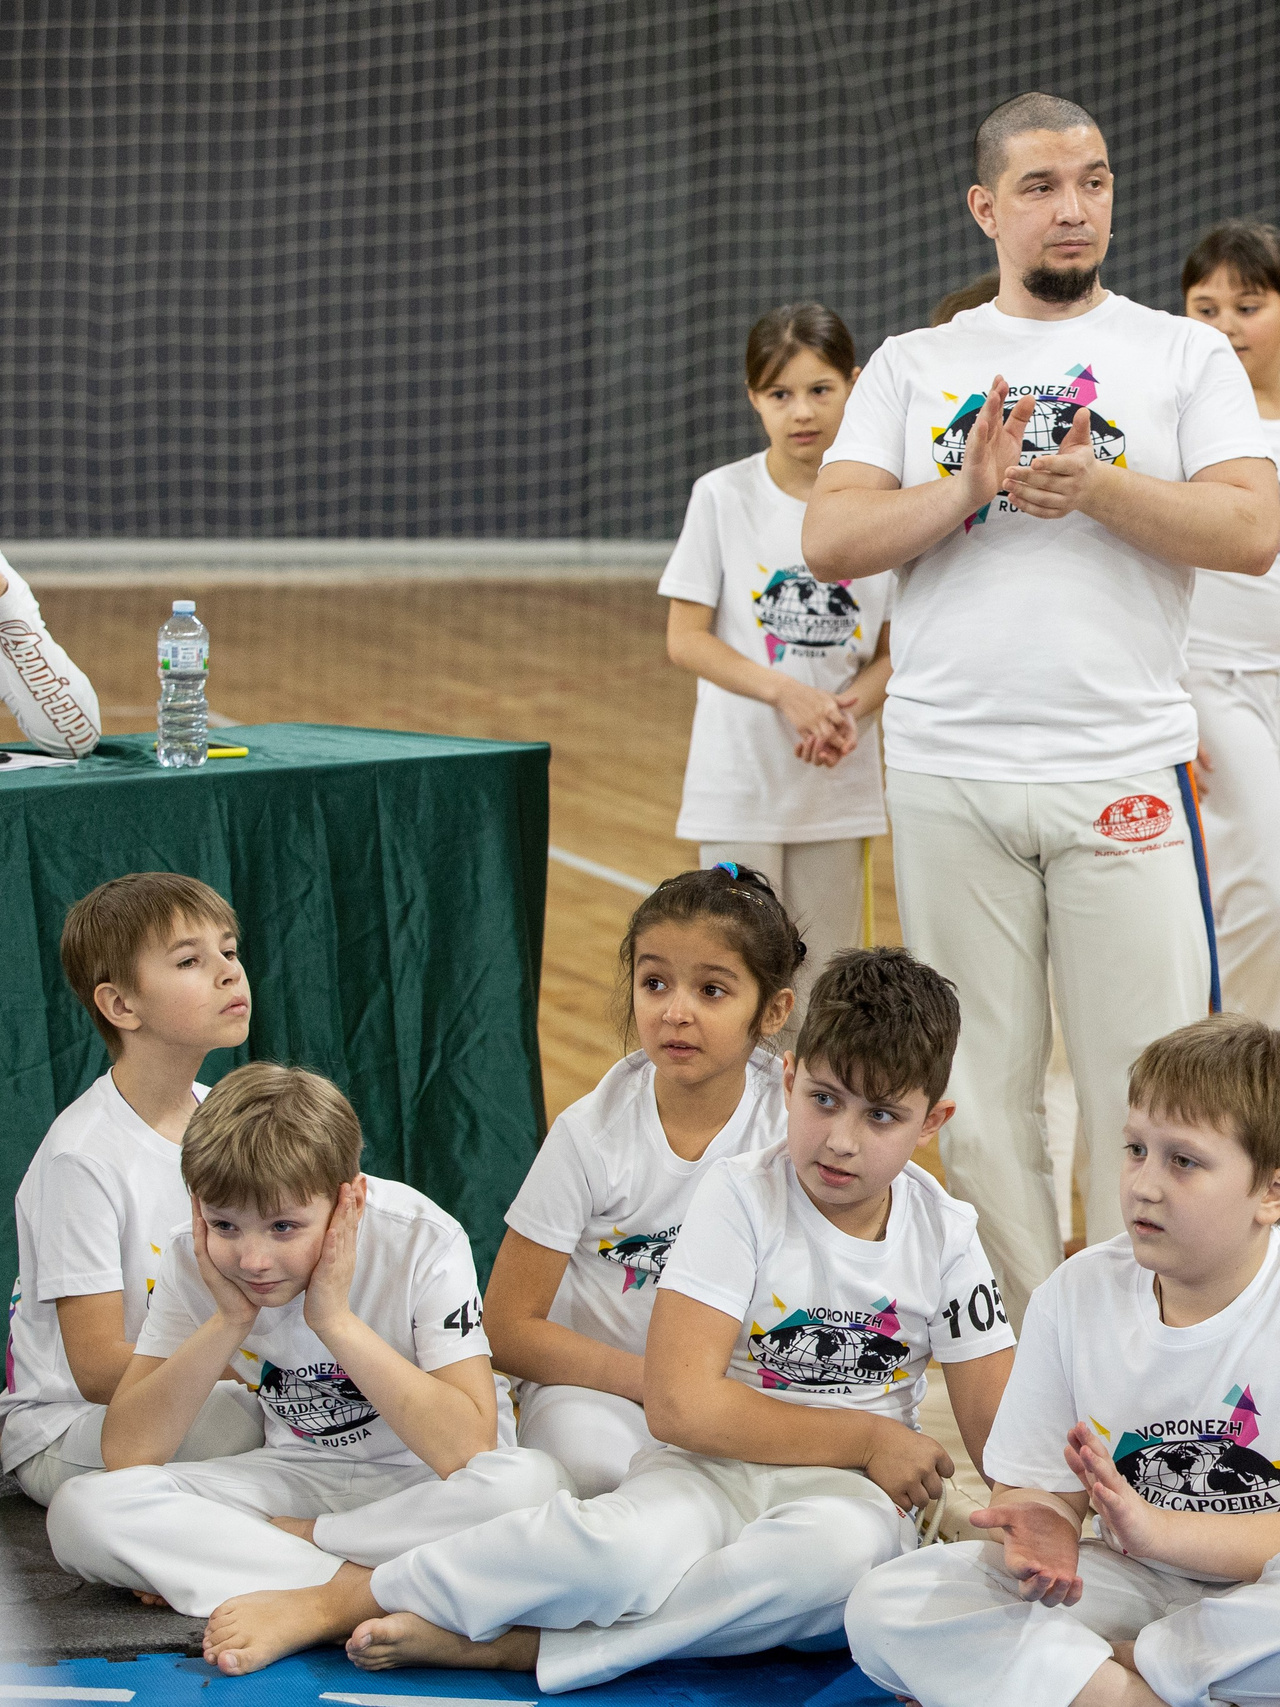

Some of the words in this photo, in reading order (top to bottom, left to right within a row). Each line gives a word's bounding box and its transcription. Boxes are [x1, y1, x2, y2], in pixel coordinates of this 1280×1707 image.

[982, 385, 1079, 399] RONEZH
[807, 1307, 883, 1328] VORONEZH
[321, 1428, 372, 1448] RUSSIA
[1136, 1419, 1243, 1440] VORONEZH
